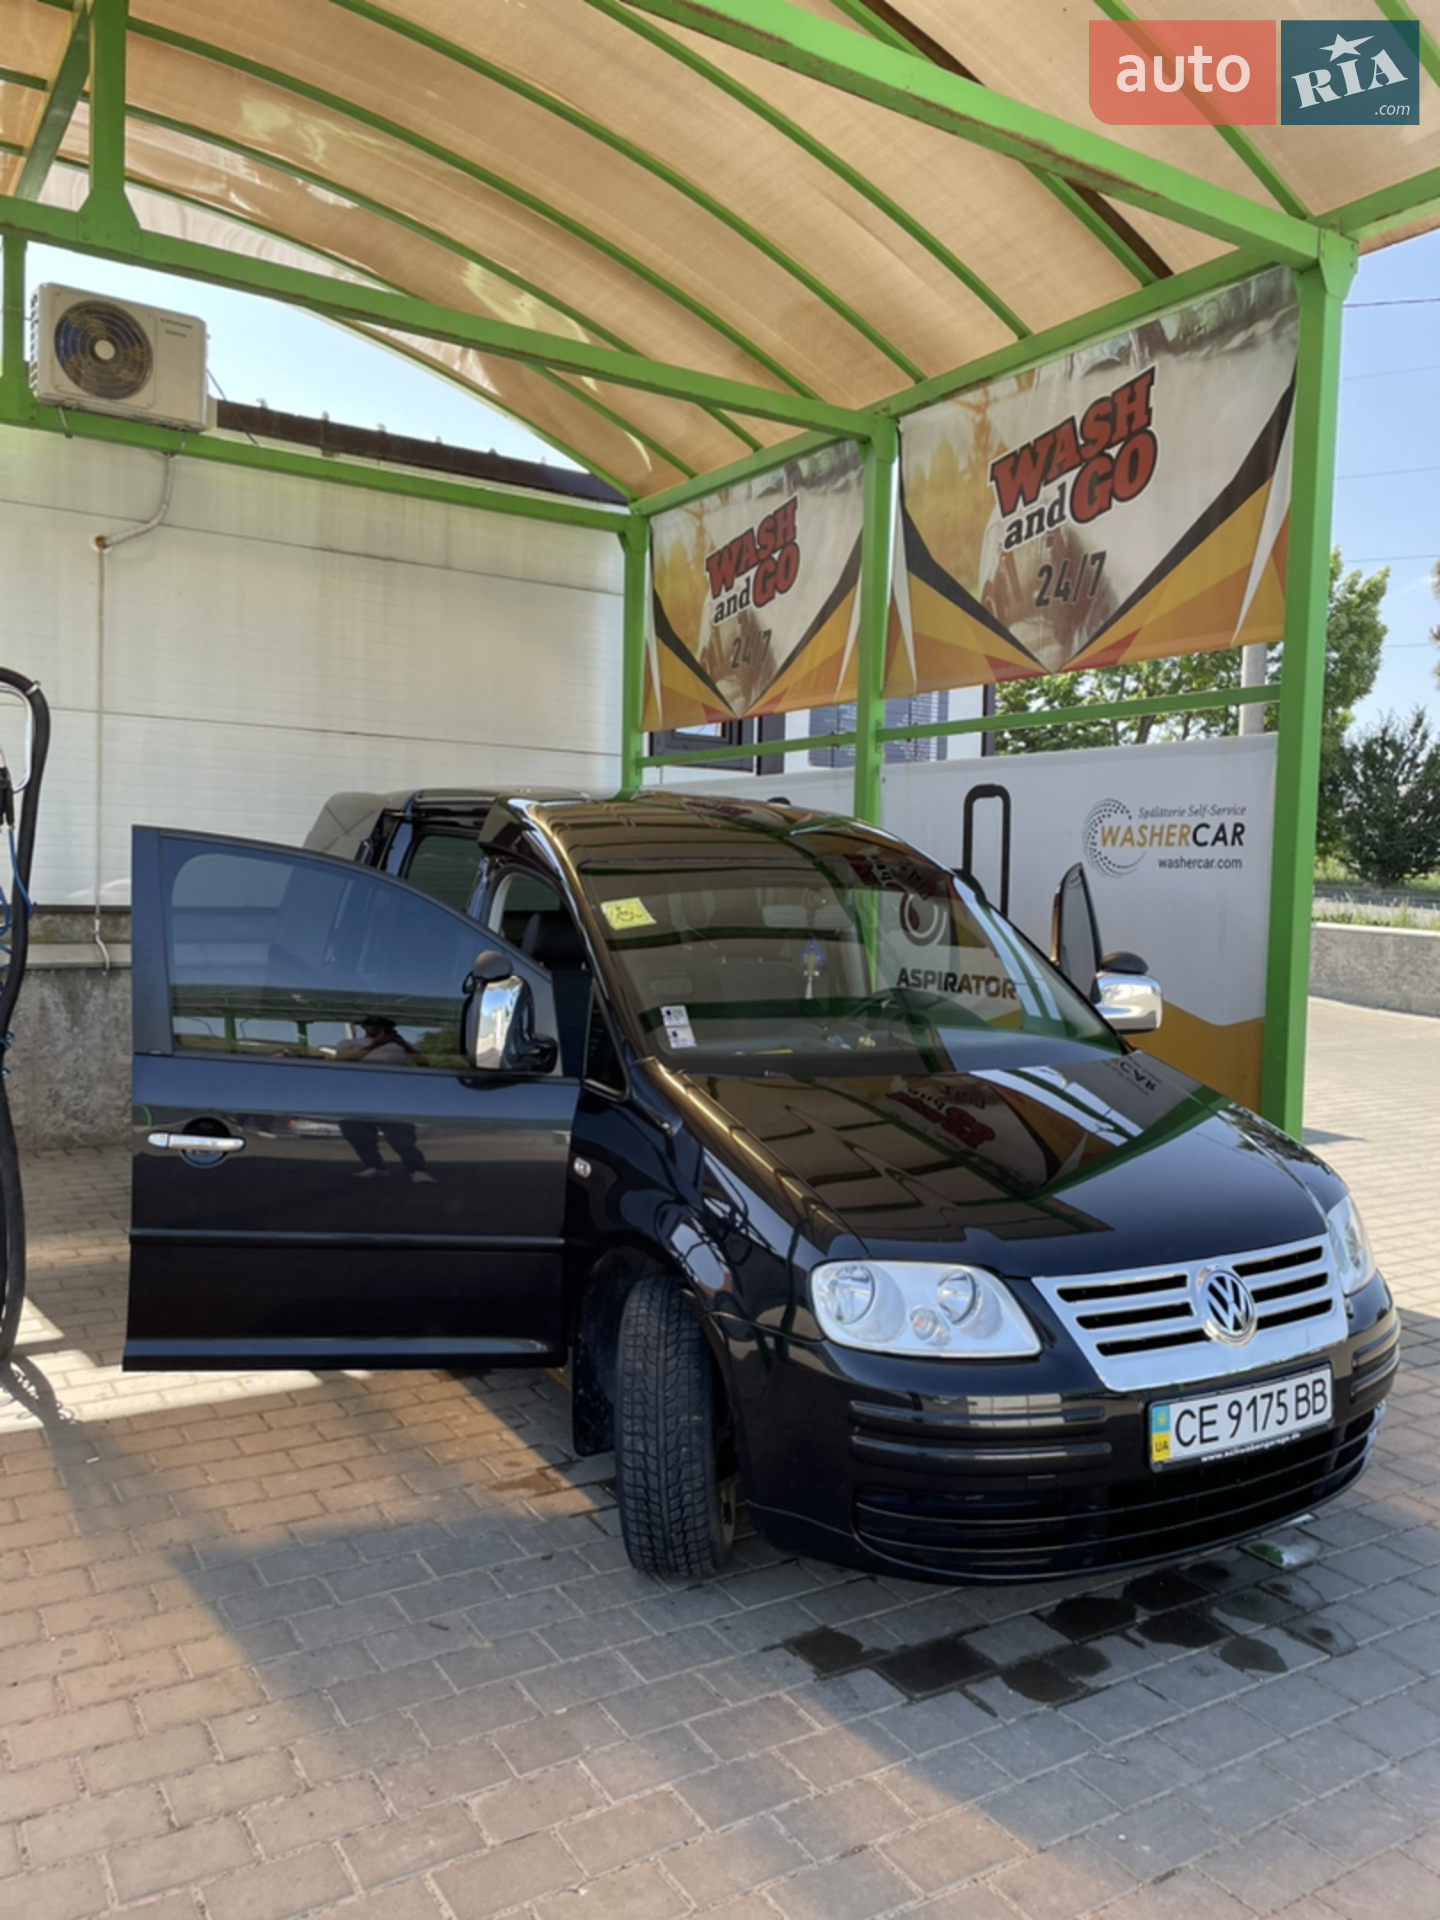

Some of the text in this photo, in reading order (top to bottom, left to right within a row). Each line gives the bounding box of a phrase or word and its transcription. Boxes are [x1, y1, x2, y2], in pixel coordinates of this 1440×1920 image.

[989, 365, 1155, 518] WASH
[1003, 428, 1158, 550] and GO
[706, 495, 797, 600] WASH
[714, 541, 799, 624] and GO
[1035, 550, 1107, 608] 24/7
[1100, 821, 1245, 848] WASHERCAR
[1187, 802, 1247, 819] Self-Service
[1157, 856, 1243, 870] washercar.com
[896, 966, 1017, 1000] ASPIRATOR
[1174, 1377, 1328, 1447] CE 9175 BB
[1155, 1440, 1169, 1453] UA
